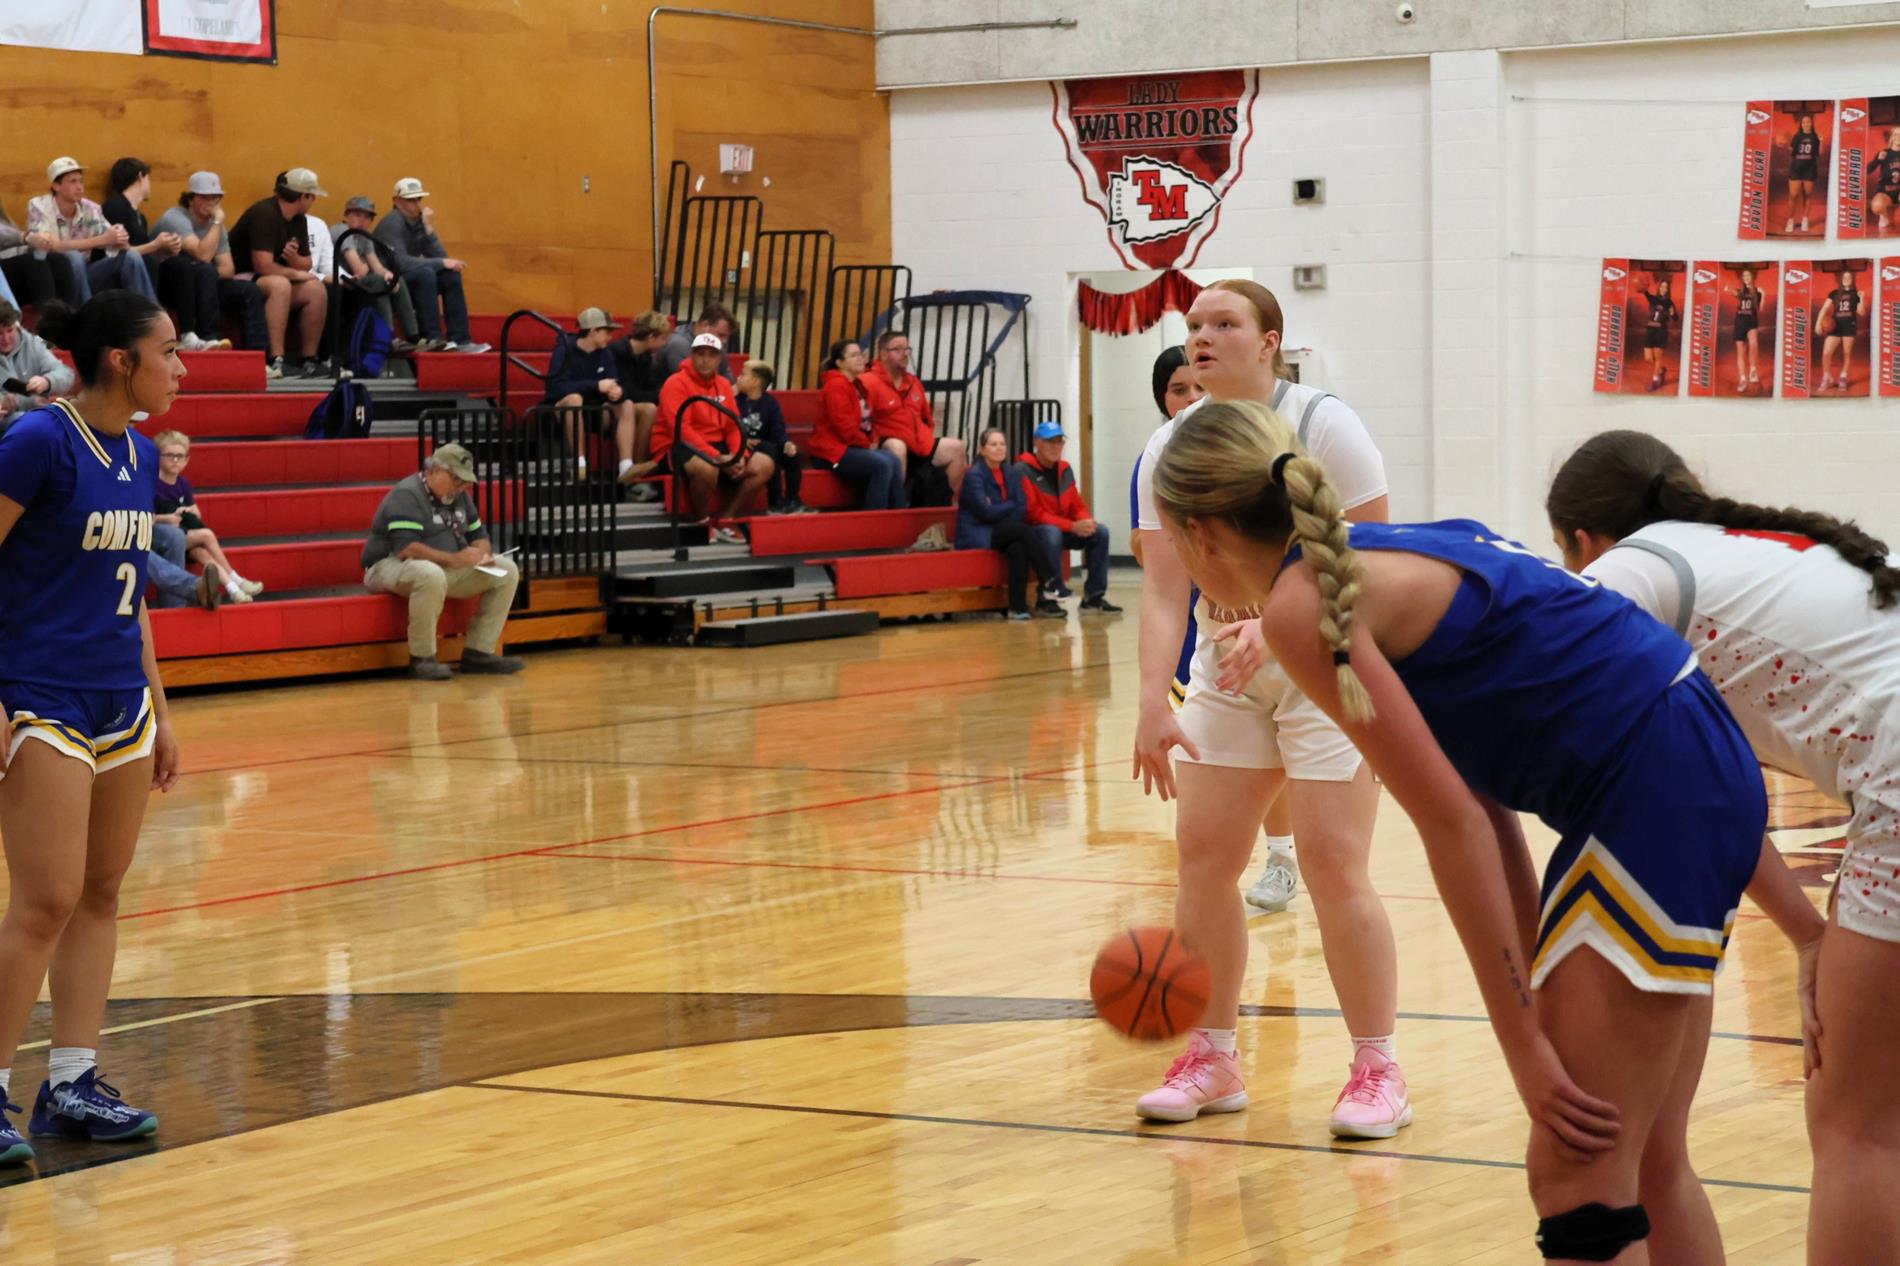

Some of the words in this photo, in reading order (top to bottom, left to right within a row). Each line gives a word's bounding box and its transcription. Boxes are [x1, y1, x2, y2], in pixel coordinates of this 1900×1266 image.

[1127, 80, 1182, 106] LADY
[1073, 106, 1238, 143] WARRIORS
[1132, 169, 1189, 221] TM
[1750, 190, 1763, 231] PAYTON
[115, 561, 137, 616] 2
